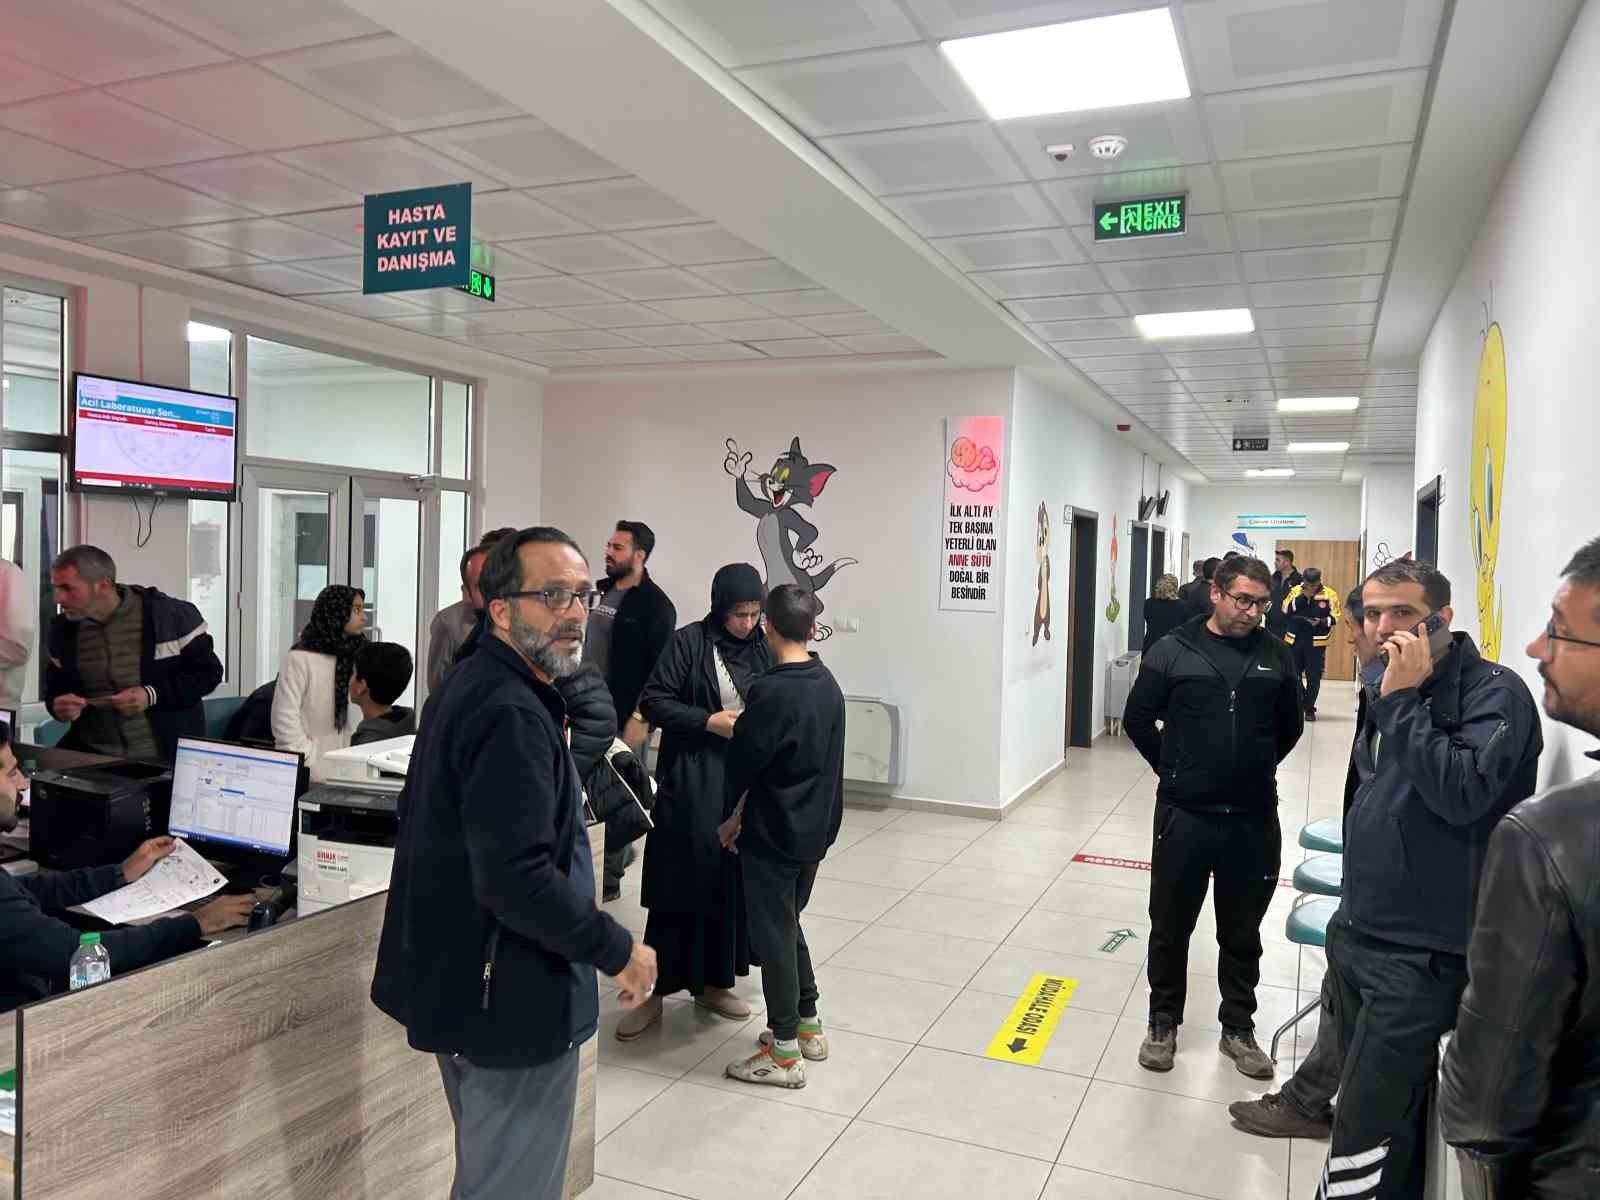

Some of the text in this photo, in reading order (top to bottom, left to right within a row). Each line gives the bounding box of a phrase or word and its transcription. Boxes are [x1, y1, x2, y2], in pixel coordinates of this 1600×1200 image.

[388, 203, 445, 225] HASTA
[1143, 200, 1181, 217] EXIT
[377, 226, 457, 249] KAYIT VE
[377, 249, 456, 273] DANIŞMA
[950, 503, 994, 518] İLK ALTI AY
[949, 521, 994, 537] TEK BAŞINA
[945, 536, 997, 551] YETERLİ OLAN
[948, 552, 992, 567] ANNE SÜTÜ
[949, 567, 989, 584] DOĞAL BİR
[951, 585, 986, 600] BESİNDİR
[1015, 978, 1066, 1035] MÜDAHALE ODASI
